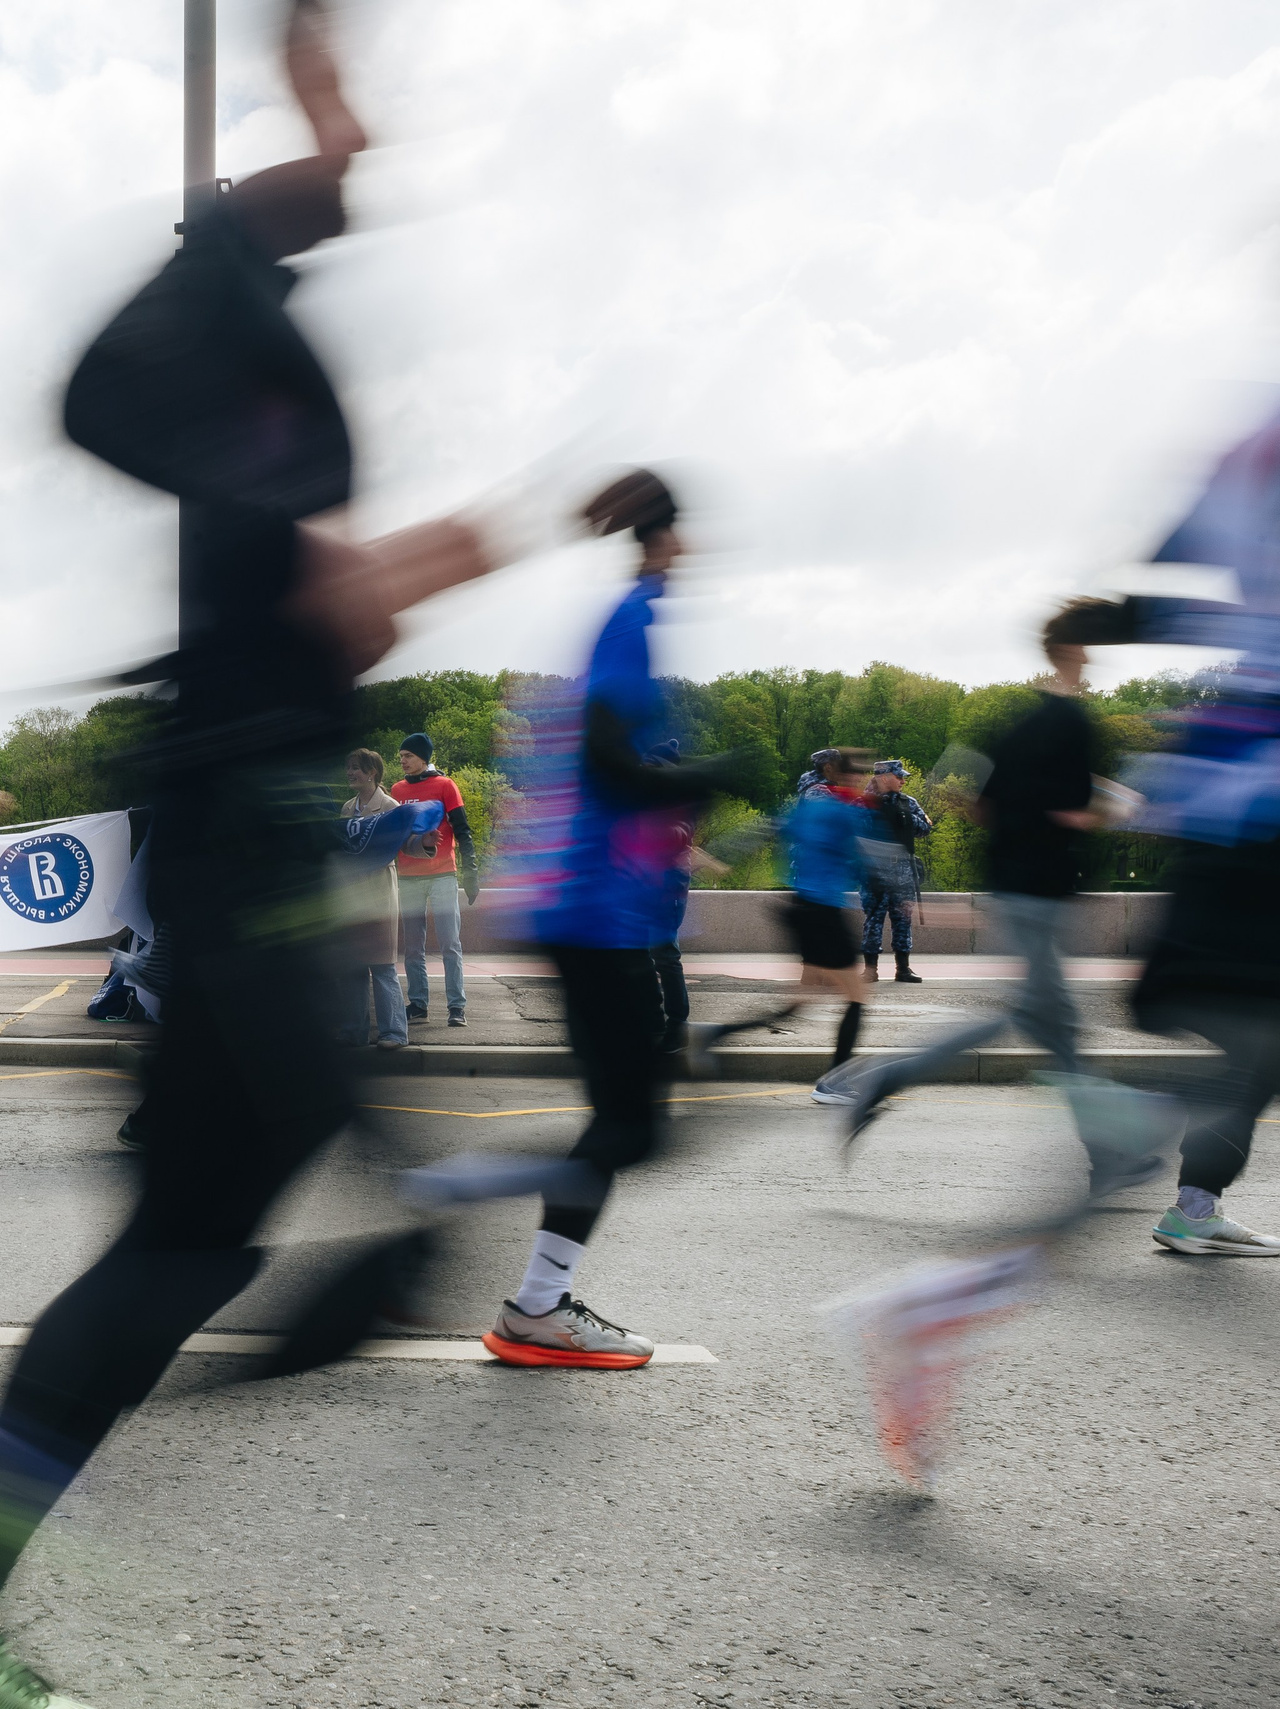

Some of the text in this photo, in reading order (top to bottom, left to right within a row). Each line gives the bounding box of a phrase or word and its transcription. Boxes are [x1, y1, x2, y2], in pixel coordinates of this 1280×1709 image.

[0, 836, 90, 920] ШКОЛА ЭКОНОМИКИ ВЫСШАЯ
